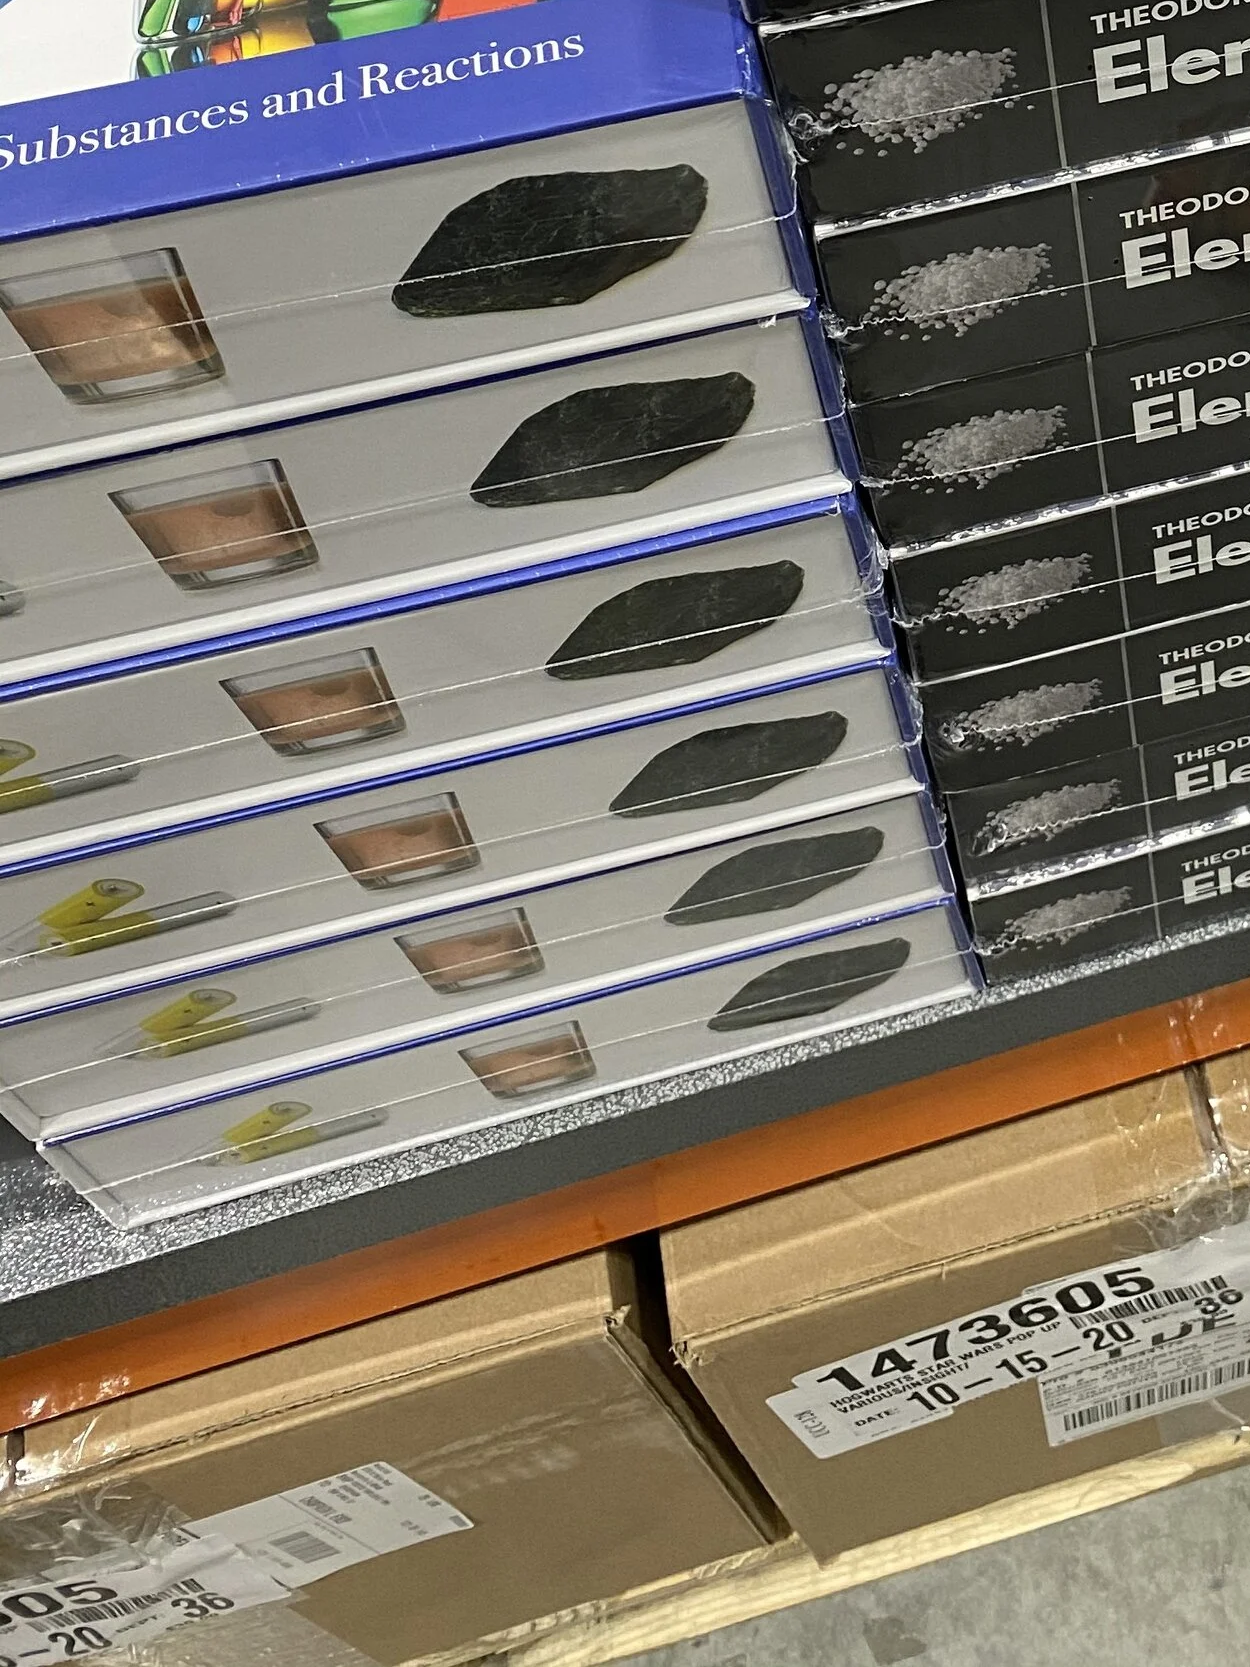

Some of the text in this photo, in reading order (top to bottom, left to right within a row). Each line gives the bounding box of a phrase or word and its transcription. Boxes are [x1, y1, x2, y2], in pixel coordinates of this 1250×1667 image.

[261, 76, 346, 121] and
[359, 30, 587, 99] Reactions
[816, 1267, 1155, 1391] 1473605
[830, 1321, 1061, 1408] HOGWARTS STAR WARS POP UP
